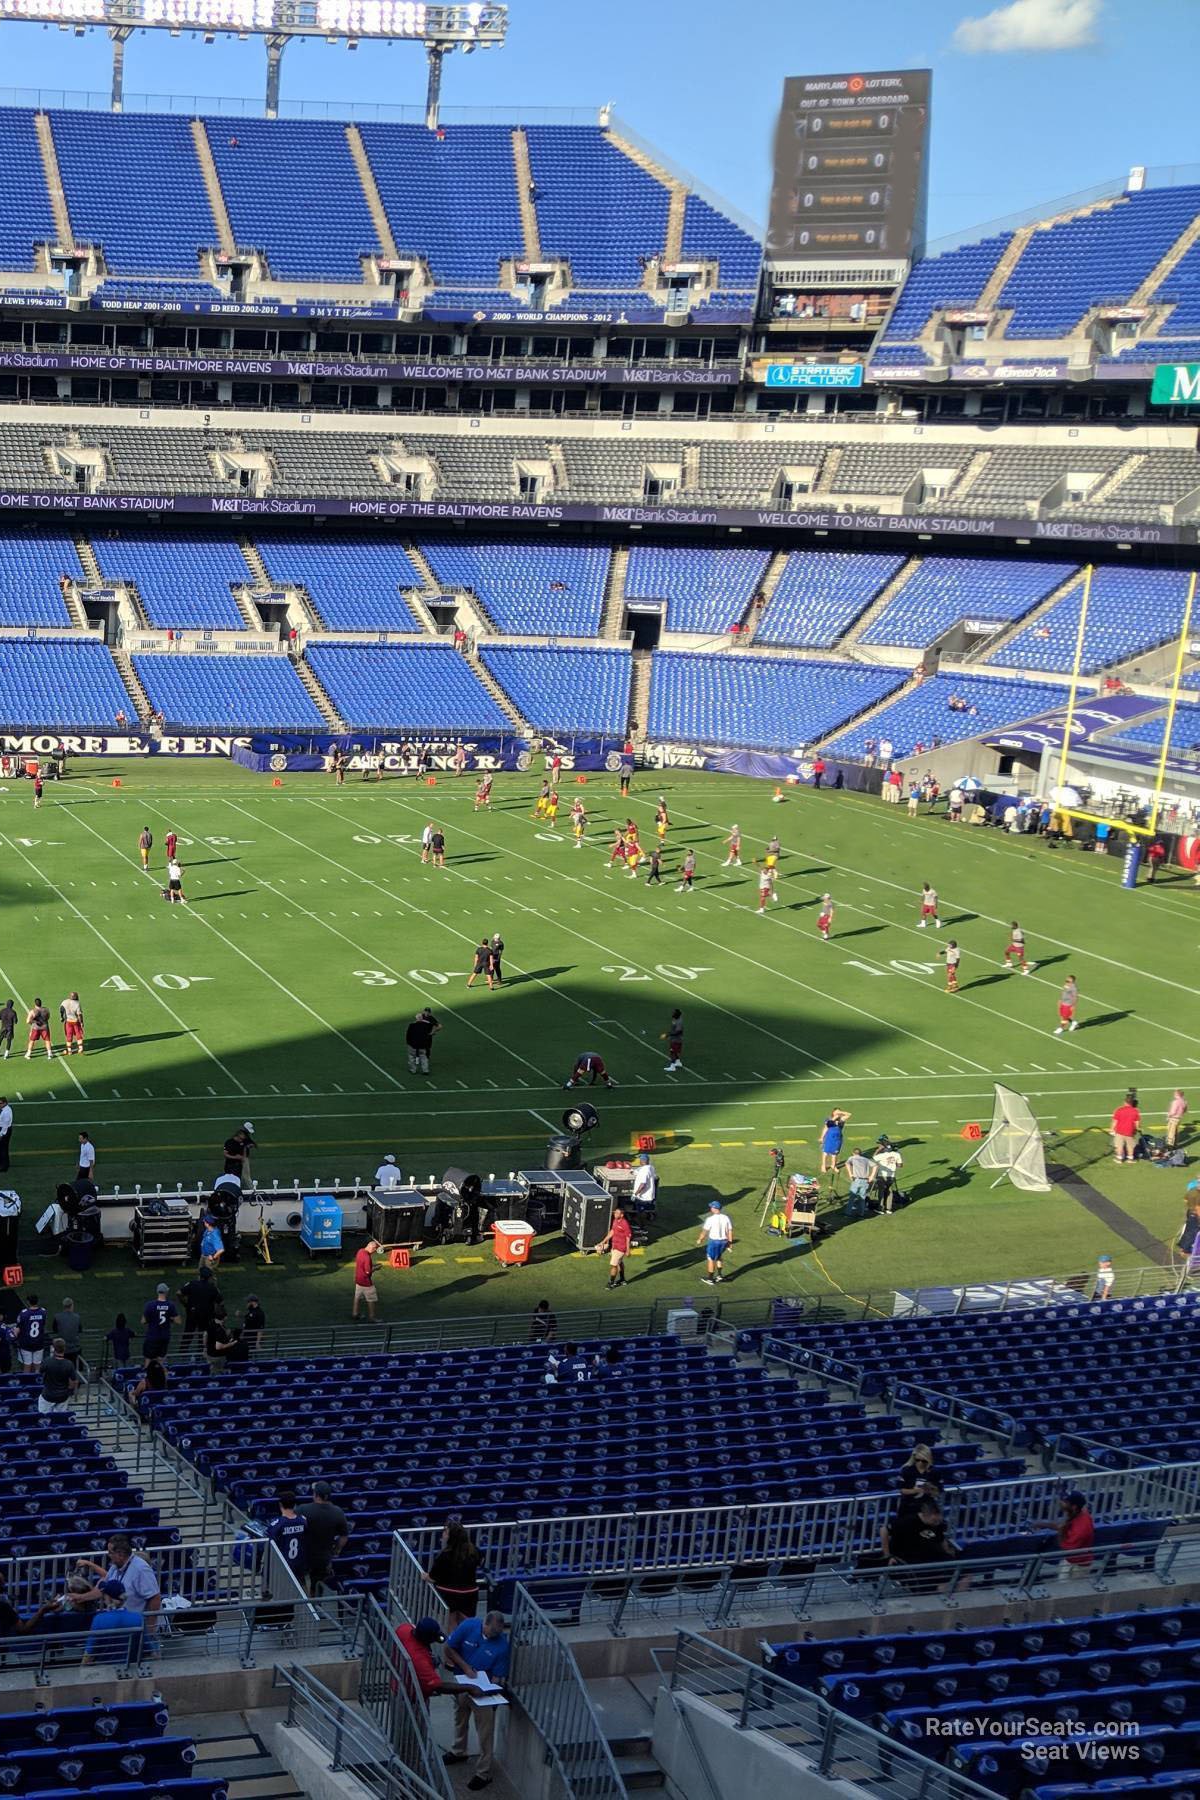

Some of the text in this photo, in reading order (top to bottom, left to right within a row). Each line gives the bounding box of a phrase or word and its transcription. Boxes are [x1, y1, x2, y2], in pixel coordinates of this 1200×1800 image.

[800, 95, 910, 109] OUT OF TOWN SCOREBOARD
[812, 118, 822, 131] 0
[879, 115, 889, 128] 0
[808, 156, 818, 169] 0
[874, 153, 884, 166] 0
[5, 297, 25, 305] LEWIS
[27, 297, 62, 306] 1996-2012
[102, 301, 181, 311] TODD HEAP 2001-2010
[211, 304, 278, 314] ED REED 2002-2012
[545, 313, 588, 321] CHAMPIONS
[71, 357, 271, 373] HOME OF THE BALTIMORE RAVENS
[287, 363, 388, 377] M&T Bank Stadium
[790, 366, 855, 376] STRATEGIC
[403, 366, 606, 380] WELCOME TO M&T BANK STADIUM
[622, 370, 731, 383] M&T Bank Stadium
[789, 375, 855, 385] FACTORY
[33, 495, 50, 506] TO
[53, 496, 80, 507] M&T
[84, 496, 117, 508] BANK
[120, 498, 174, 509] STADIUM
[350, 503, 562, 518] HOME OF THE BALTIMORE RAVENS
[603, 508, 716, 522] M&T Bank Stadium
[758, 513, 994, 532] WELCOME TO M&T BANK STADIUM
[1035, 523, 1159, 541] M&T Bank Stadium
[969, 1126, 980, 1138] 20
[641, 1137, 654, 1150] 30
[509, 1238, 525, 1256] G
[394, 1251, 409, 1266] 40
[7, 1268, 22, 1281] 50
[159, 1310, 167, 1325] 5
[30, 1321, 39, 1338] 8
[577, 1371, 584, 1381] 8
[282, 1524, 304, 1535] JACKSON
[287, 1538, 299, 1559] 8
